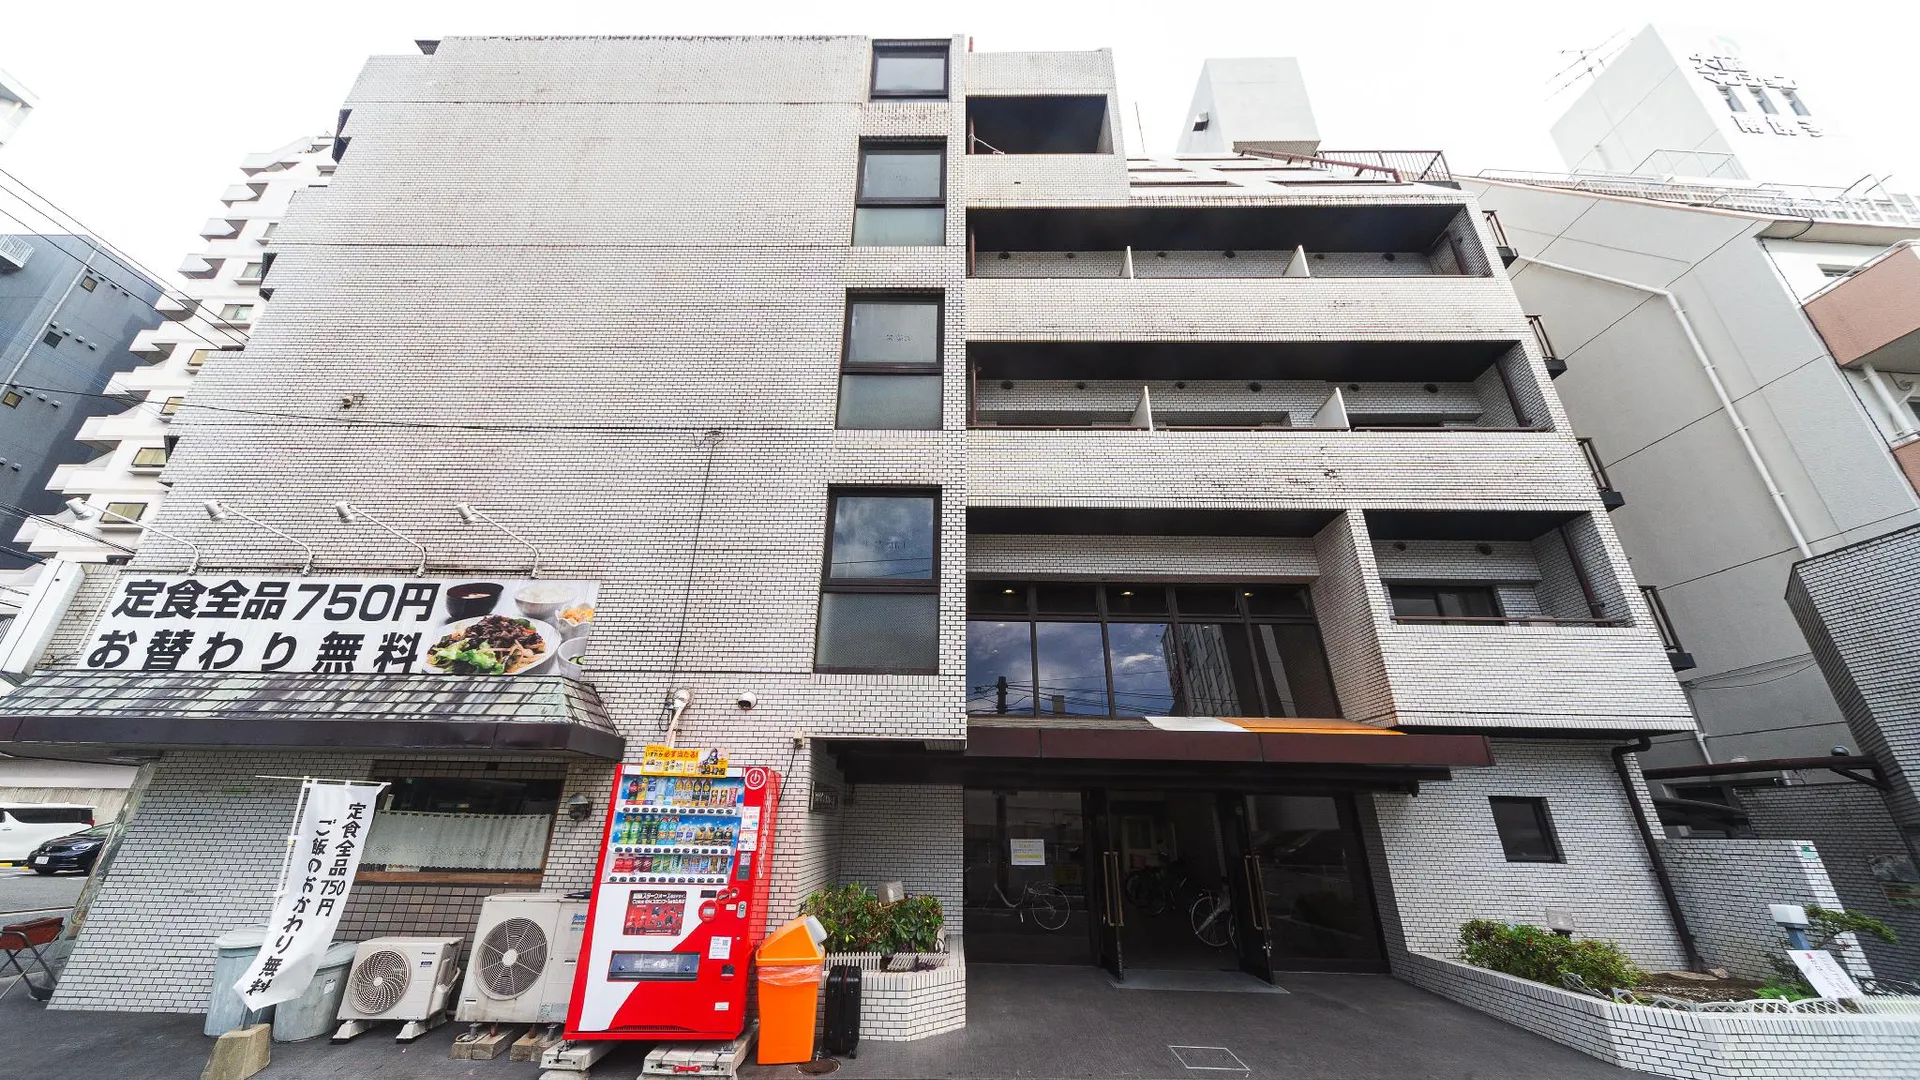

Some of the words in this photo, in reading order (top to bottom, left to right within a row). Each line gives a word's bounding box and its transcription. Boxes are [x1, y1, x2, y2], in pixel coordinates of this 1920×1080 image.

[111, 579, 441, 622] 定食全品750円
[87, 629, 423, 673] お替わり無料
[316, 802, 367, 917] 定食全品750円
[246, 819, 337, 996] ご飯のおかわり無料
